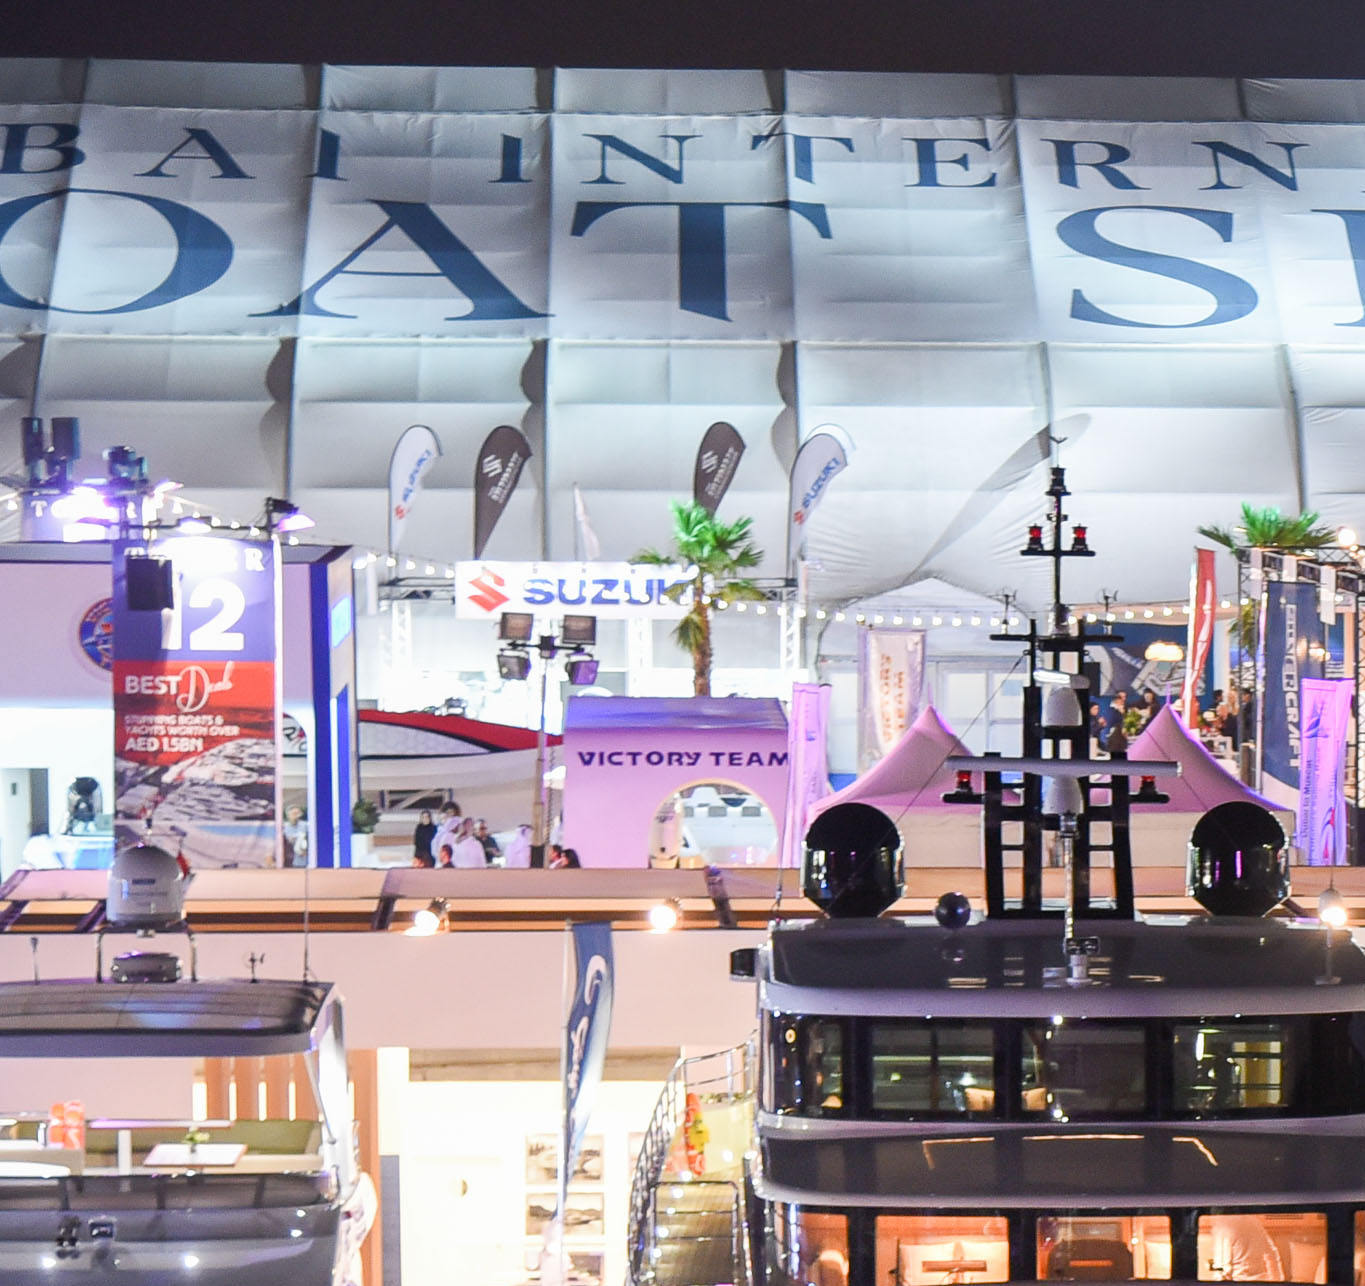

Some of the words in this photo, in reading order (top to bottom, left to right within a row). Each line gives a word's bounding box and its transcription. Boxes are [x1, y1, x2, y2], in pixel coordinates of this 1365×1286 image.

[523, 578, 692, 606] SUZUK
[125, 674, 182, 695] BEST
[209, 726, 241, 736] OVER
[125, 737, 160, 752] AED
[577, 751, 703, 767] VICTORY
[710, 751, 789, 767] TEAM
